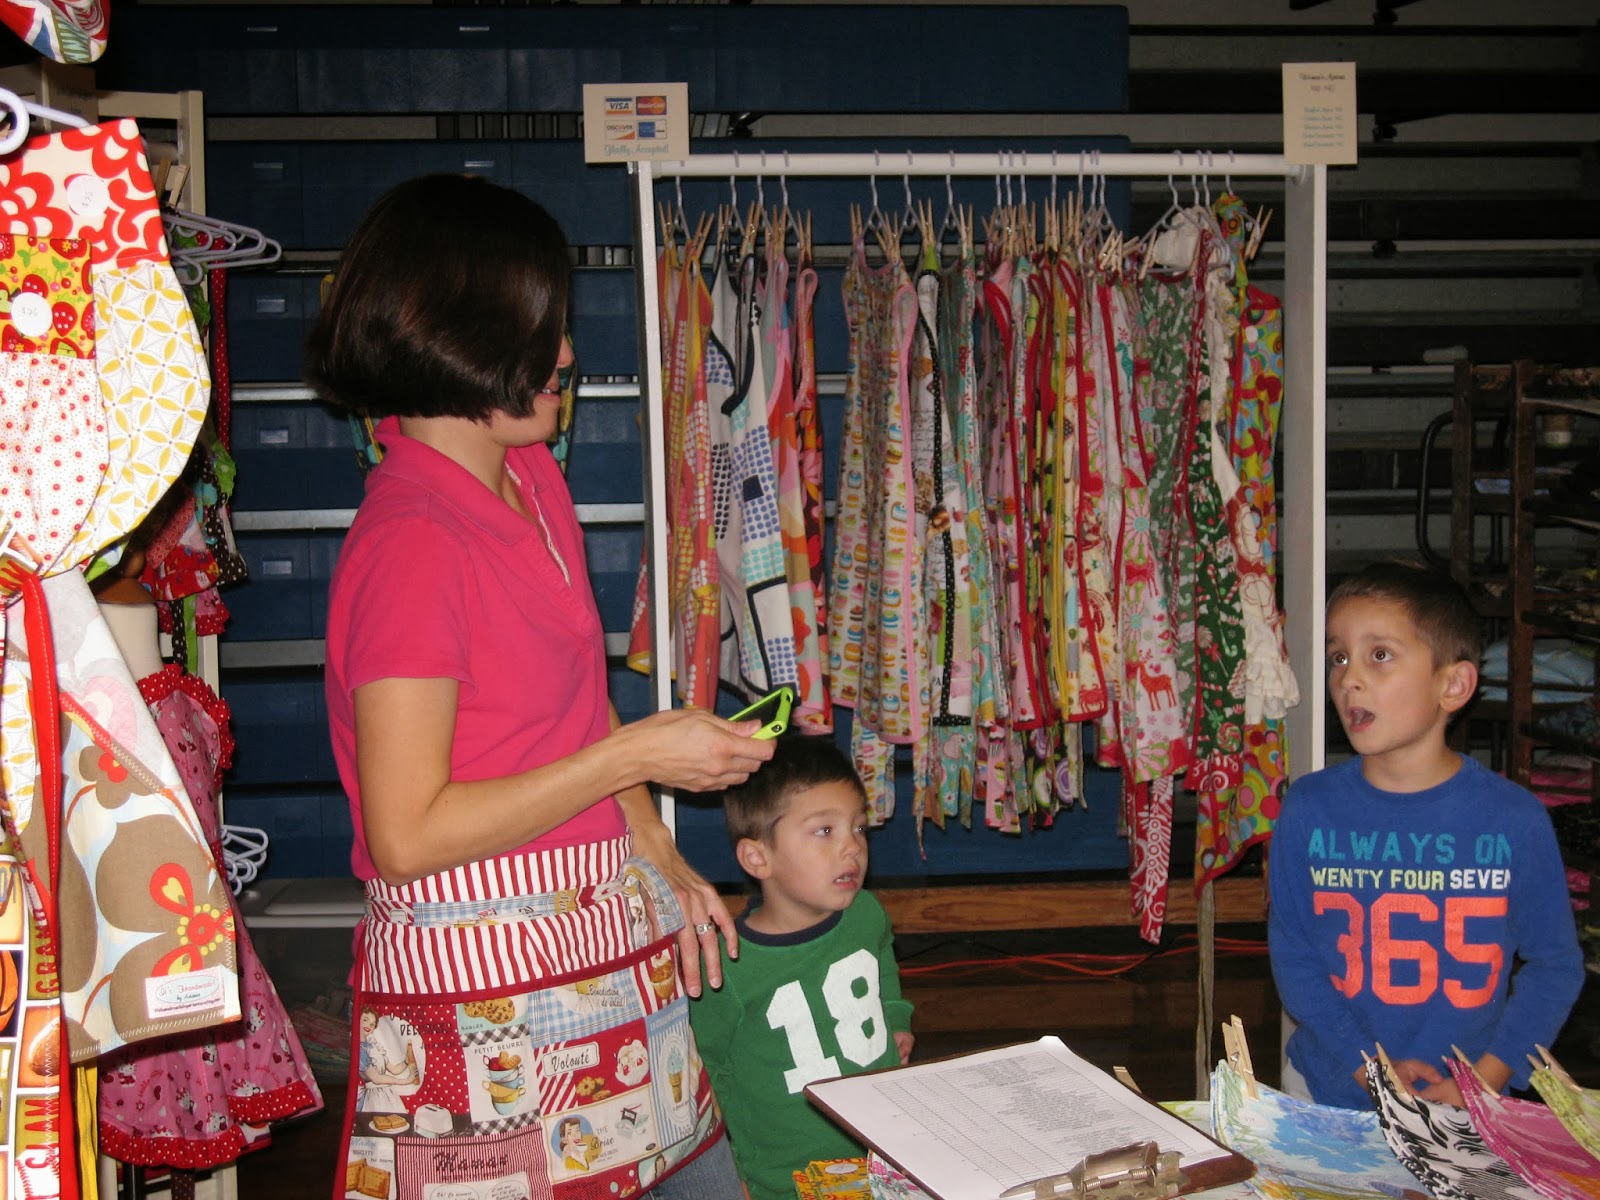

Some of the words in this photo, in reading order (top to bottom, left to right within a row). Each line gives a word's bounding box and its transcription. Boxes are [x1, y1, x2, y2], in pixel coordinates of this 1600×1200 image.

[1307, 827, 1456, 865] ALWAYS
[1475, 832, 1513, 865] ON
[1309, 866, 1384, 889] WENTY
[1390, 869, 1445, 891] FOUR
[1312, 890, 1509, 1009] 365
[765, 948, 888, 1094] 18
[474, 1046, 494, 1055] PETIT
